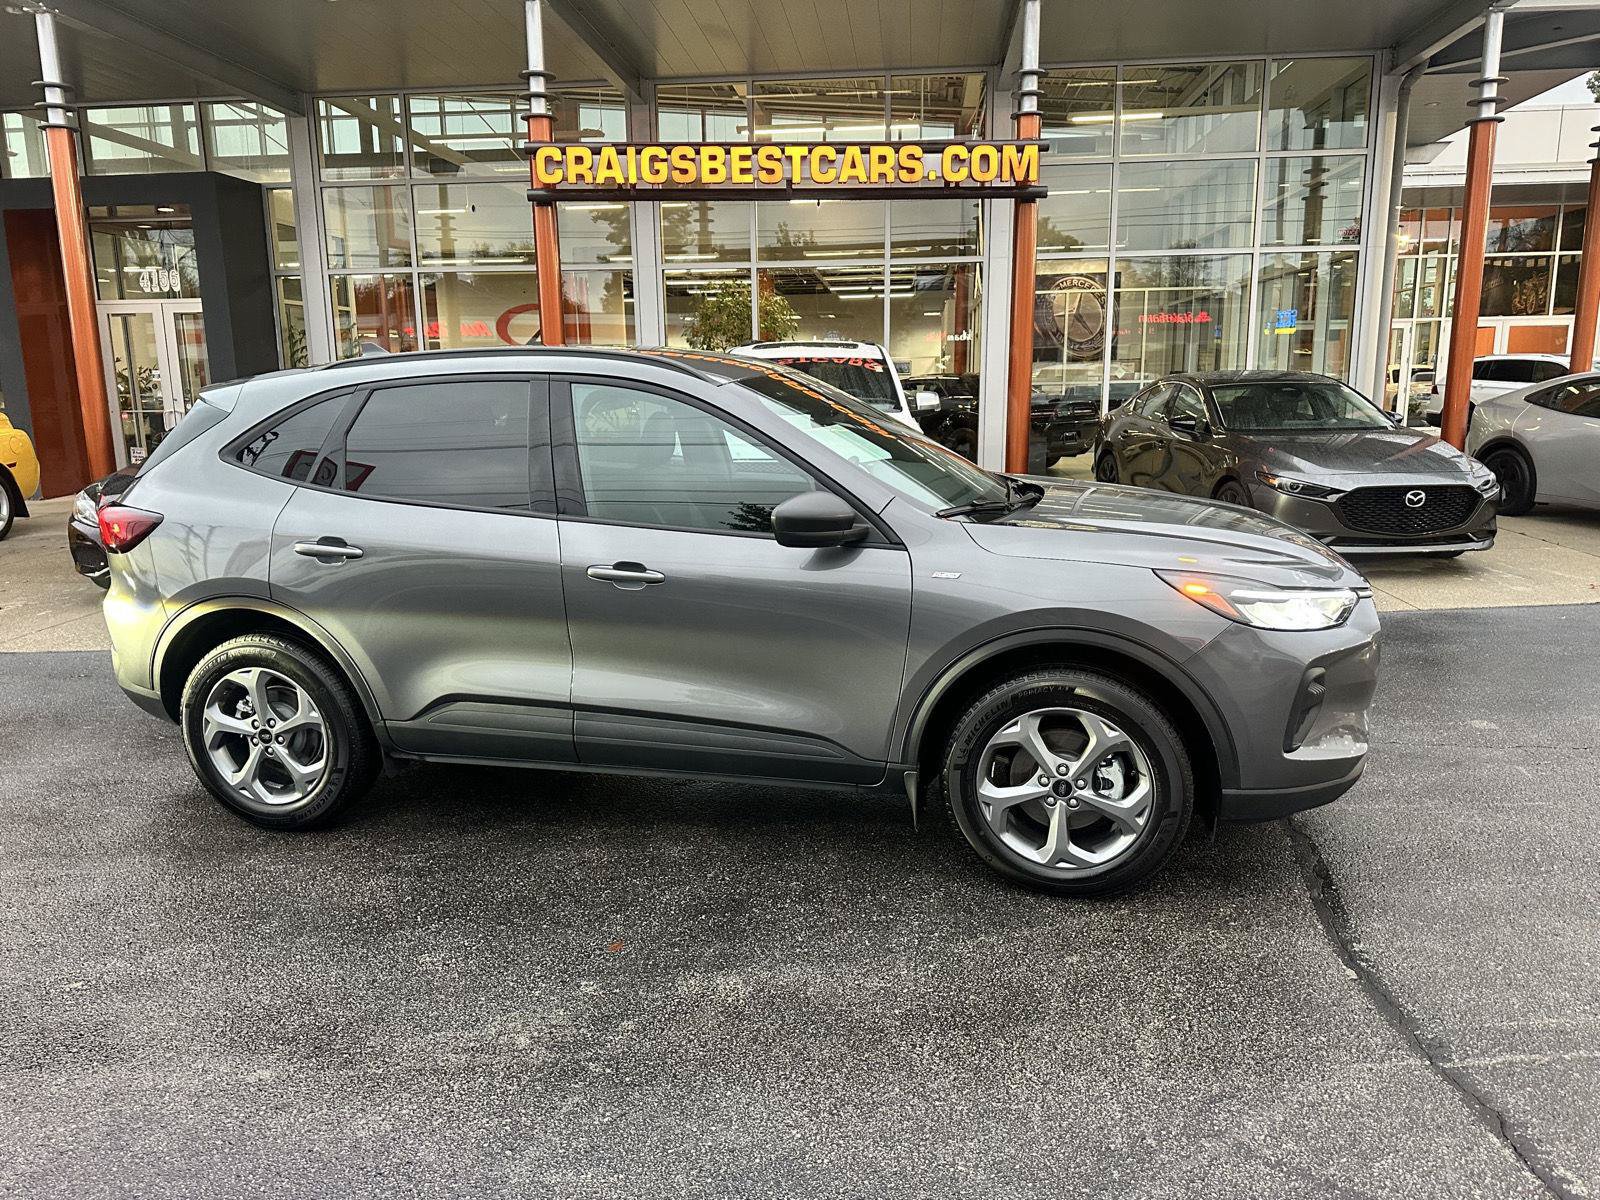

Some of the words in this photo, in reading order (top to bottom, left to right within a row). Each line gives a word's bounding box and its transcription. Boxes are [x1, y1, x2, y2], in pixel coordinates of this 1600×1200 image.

[535, 145, 1039, 184] CRAIGSBESTCARS.COM
[140, 269, 180, 292] 4156
[964, 699, 1009, 746] MICHELIN
